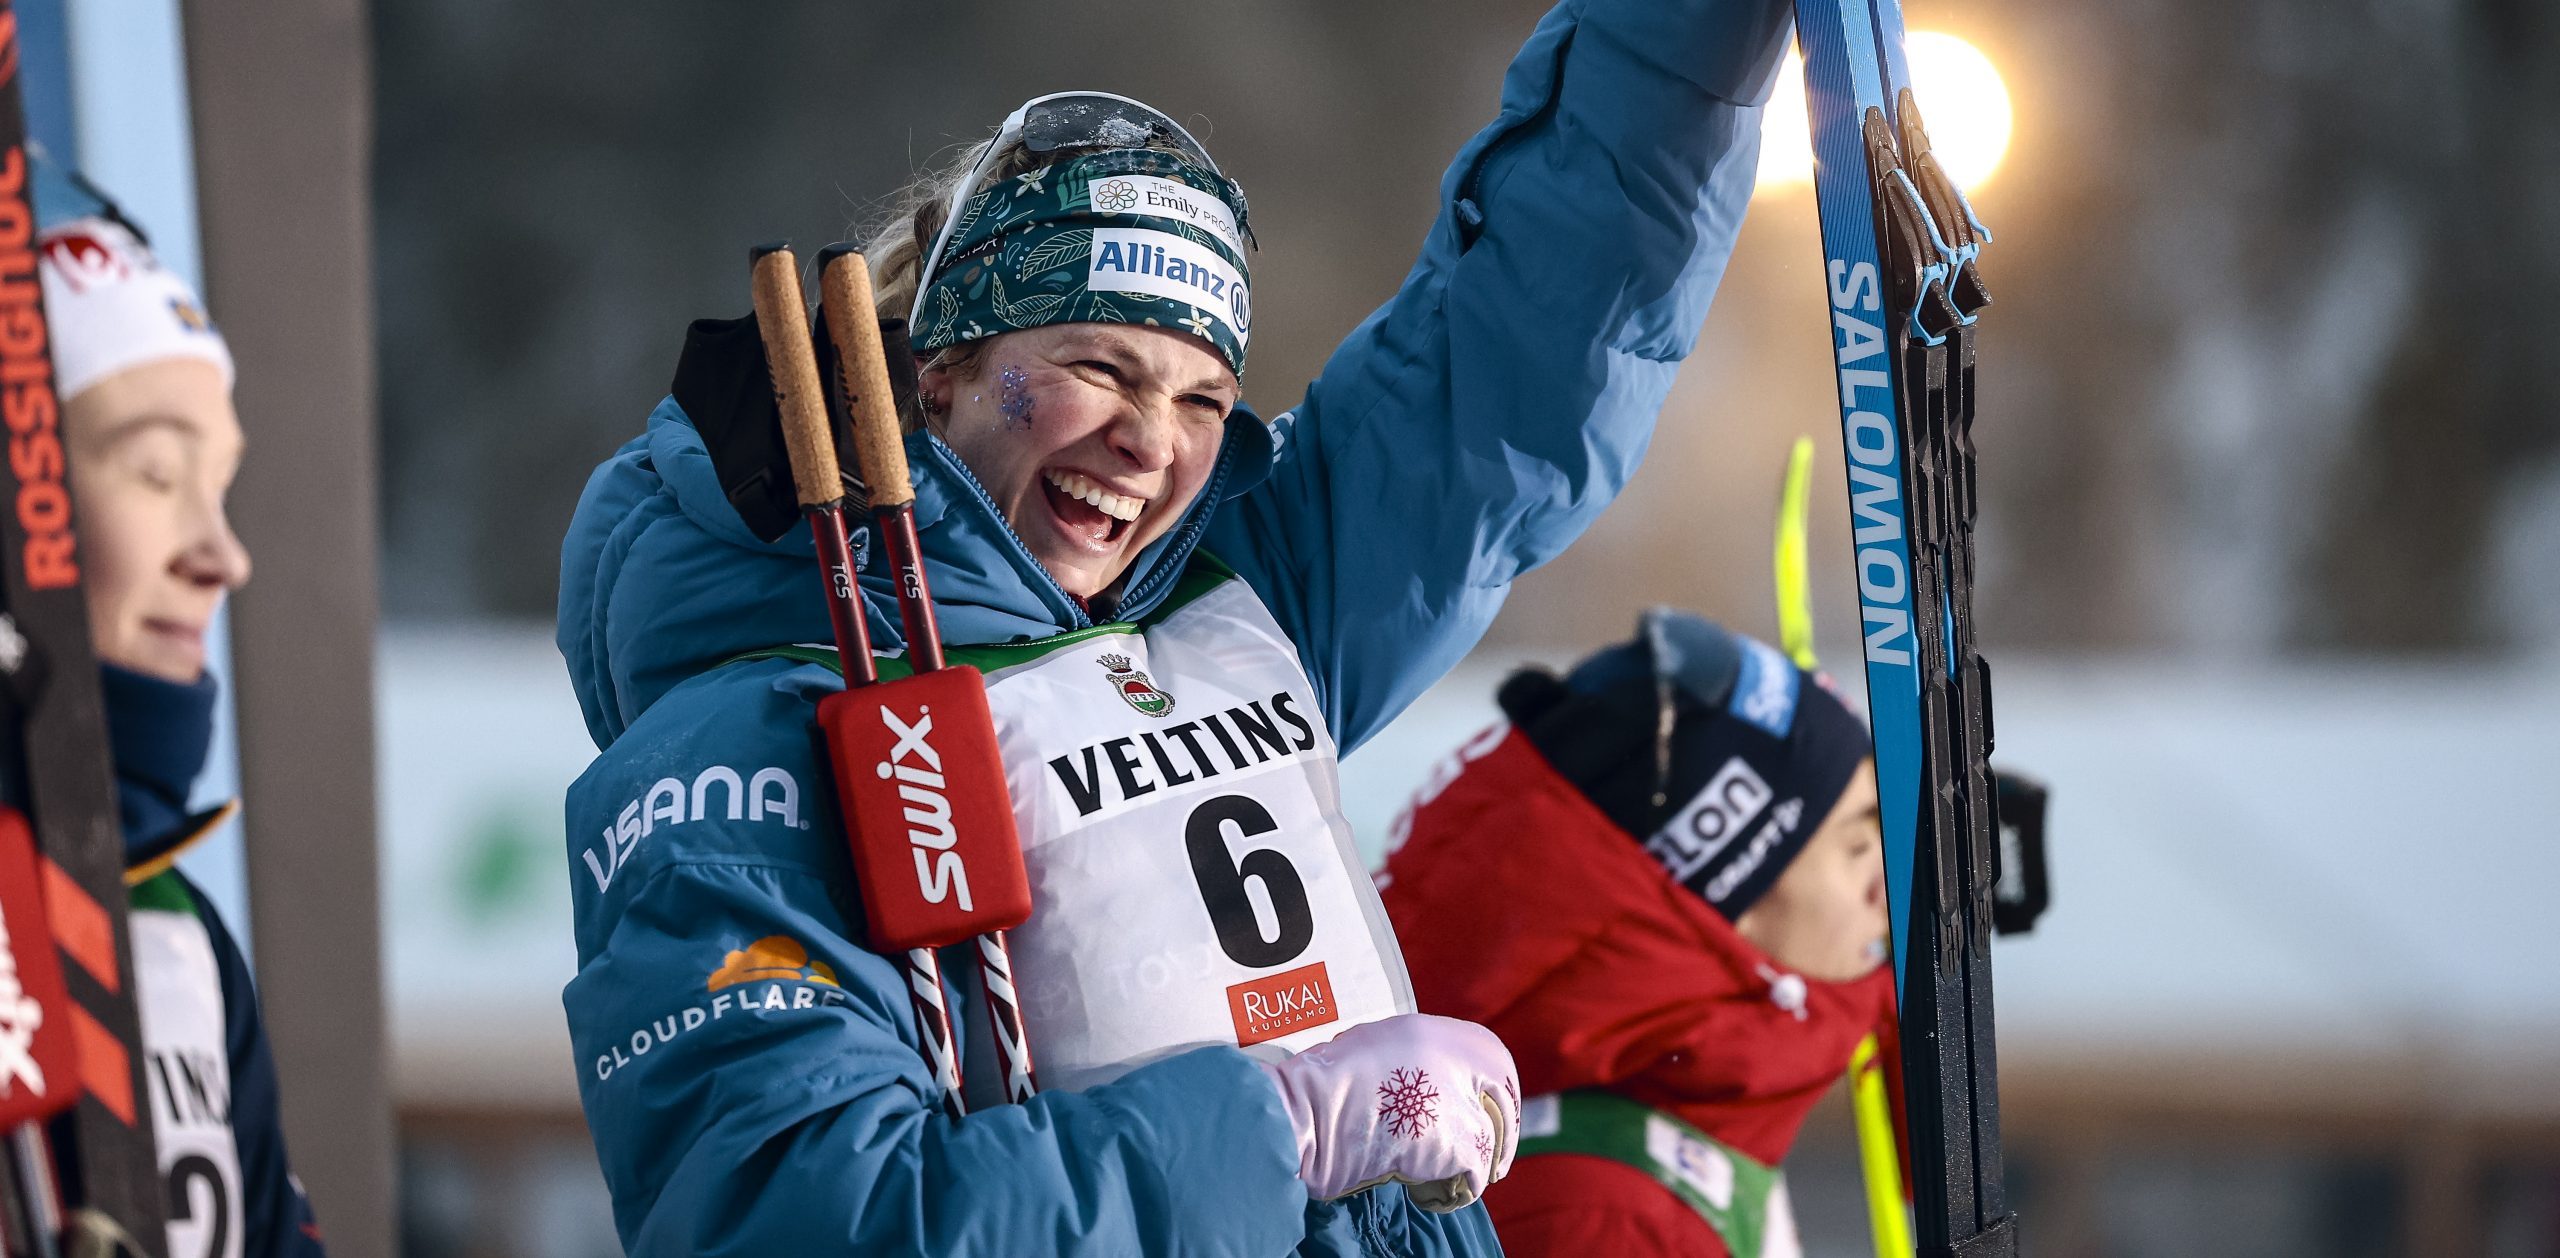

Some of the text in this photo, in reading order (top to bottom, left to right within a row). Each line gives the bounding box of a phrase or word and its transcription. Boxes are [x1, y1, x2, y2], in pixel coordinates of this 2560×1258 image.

[1147, 191, 1198, 218] Emily
[1152, 182, 1175, 194] THE
[1094, 241, 1225, 302] Allianz
[1828, 258, 1911, 666] SALOMON
[1047, 691, 1315, 817] VELTINS
[582, 766, 799, 894] USANA
[1185, 794, 1314, 968] 6
[596, 984, 845, 1081] CLOUDFLARE
[1242, 981, 1324, 1023] RUKA!
[1250, 1006, 1327, 1035] KUUSAMO
